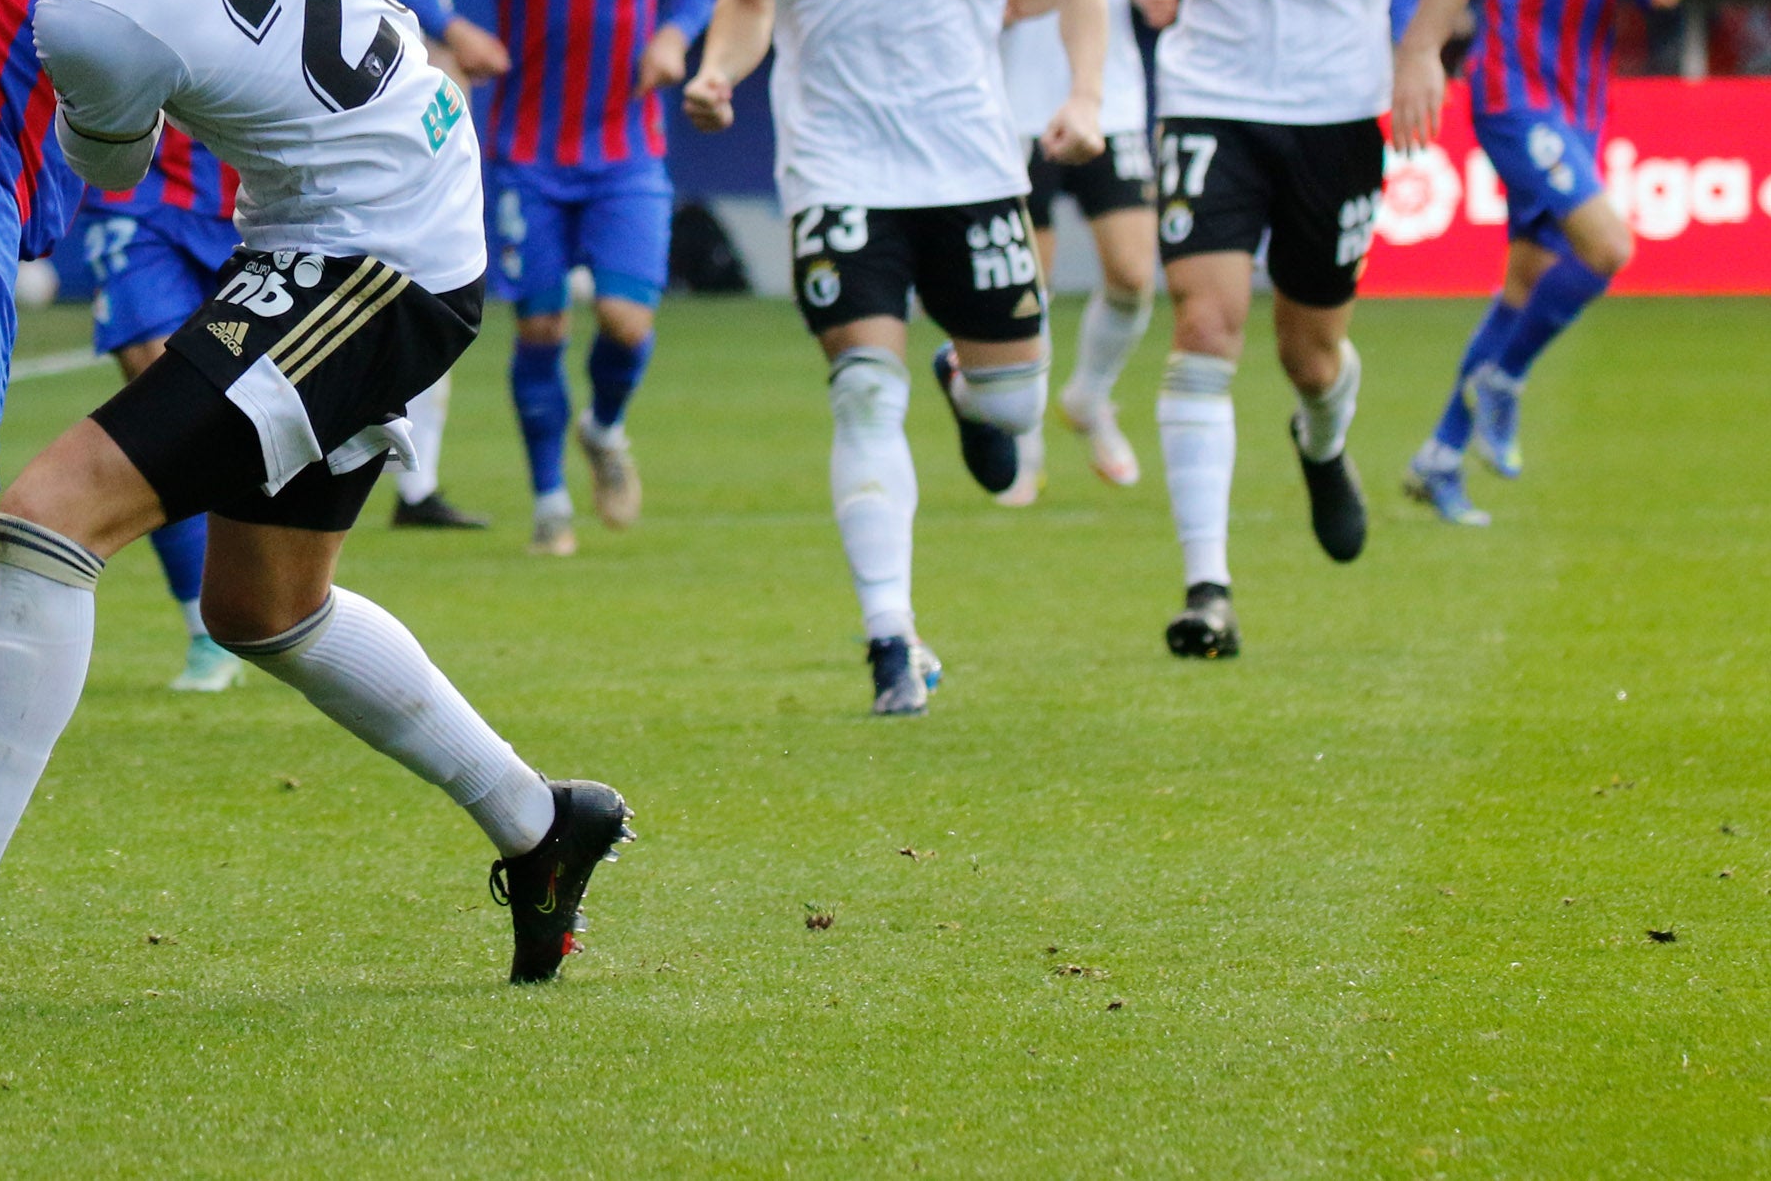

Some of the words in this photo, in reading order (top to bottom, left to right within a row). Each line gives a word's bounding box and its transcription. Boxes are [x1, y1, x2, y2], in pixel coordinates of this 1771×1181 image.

[1159, 132, 1218, 197] 17
[796, 204, 869, 259] 23
[245, 261, 271, 276] GRUPO
[971, 242, 1036, 290] nb
[214, 271, 294, 317] nb
[207, 322, 243, 357] adidas
